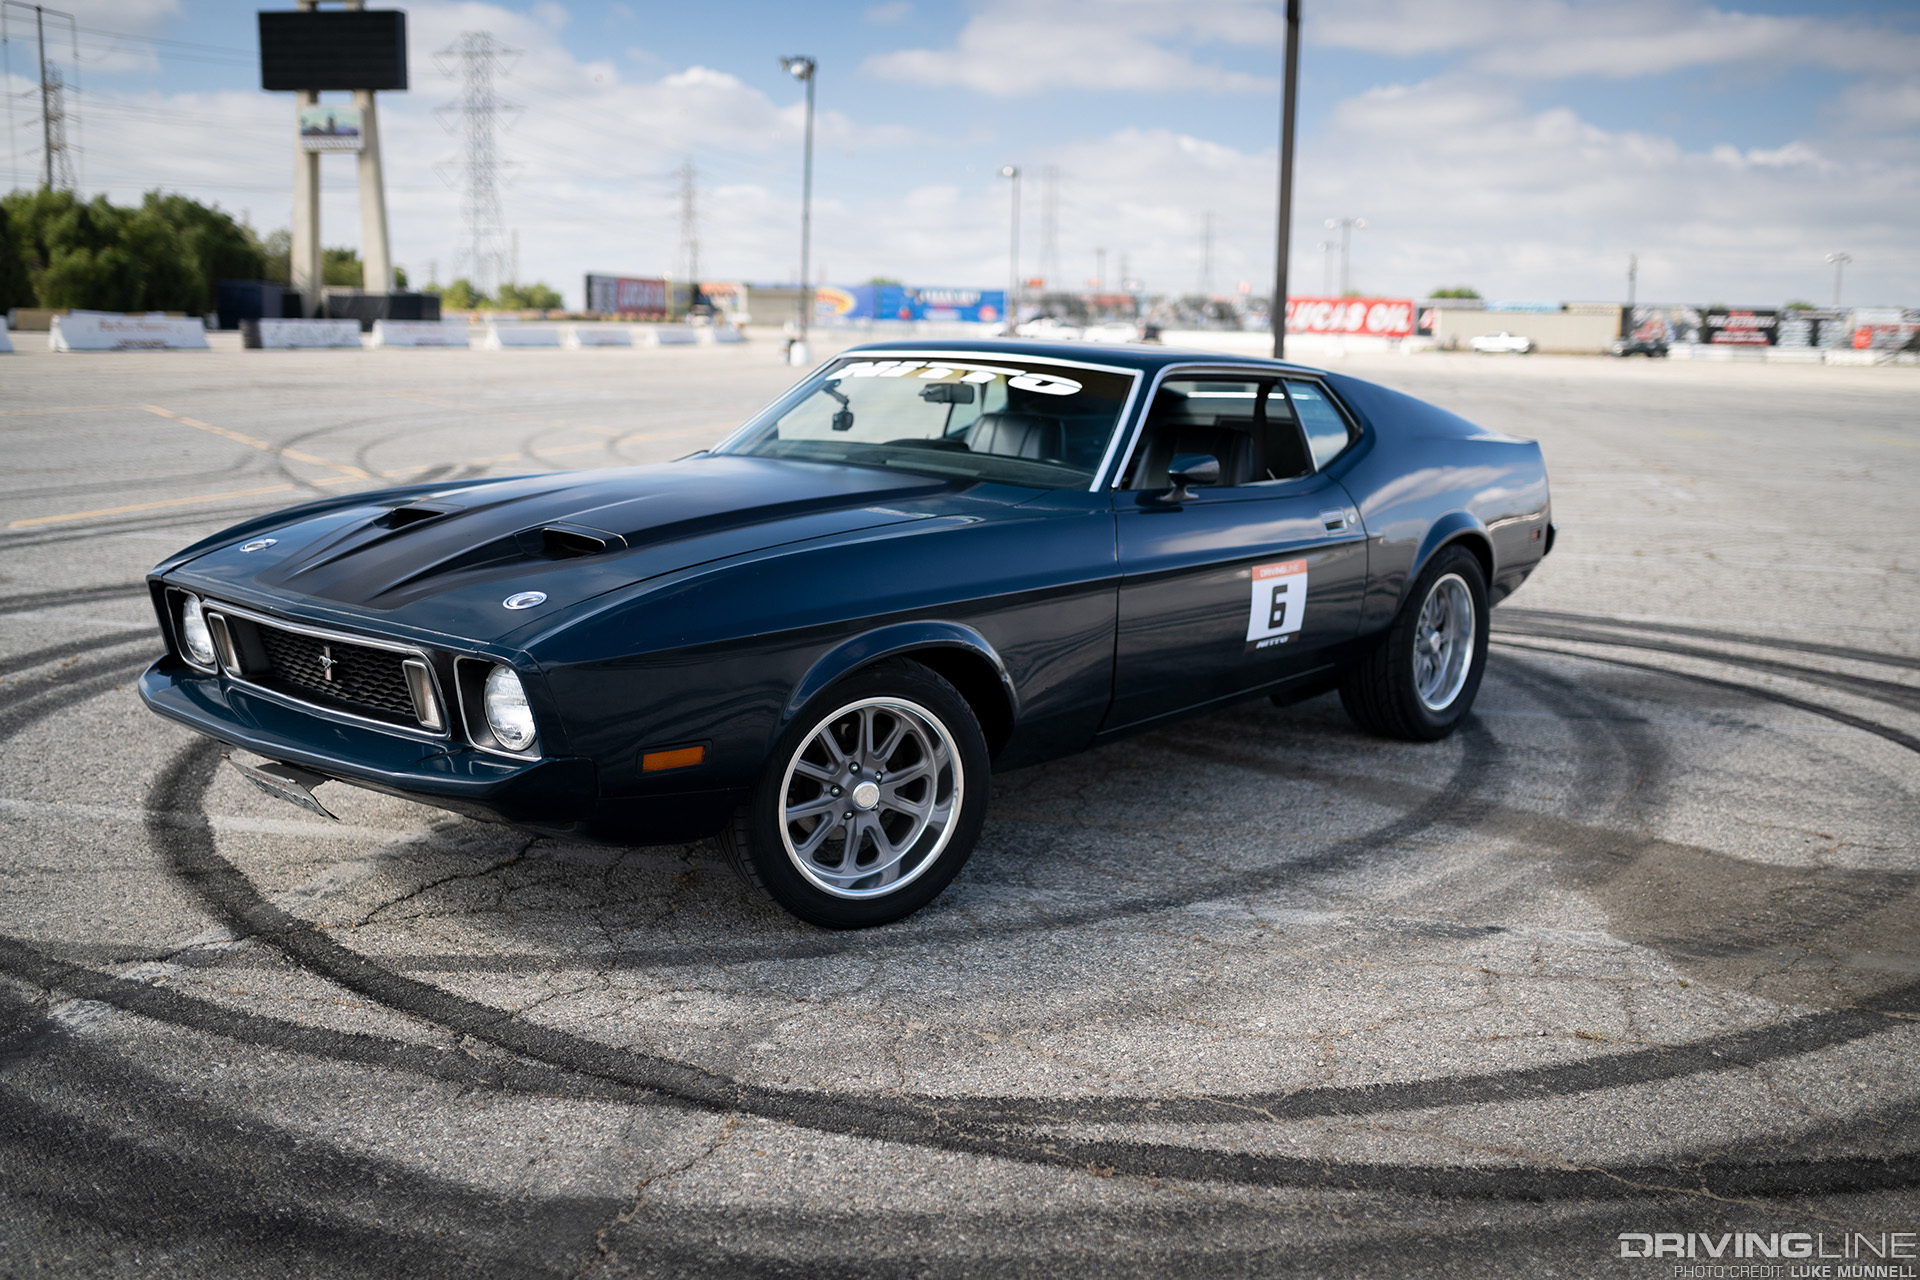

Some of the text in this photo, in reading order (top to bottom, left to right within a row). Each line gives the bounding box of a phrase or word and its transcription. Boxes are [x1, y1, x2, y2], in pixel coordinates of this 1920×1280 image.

[1366, 302, 1411, 333] OIL
[825, 361, 1083, 396] NITTO
[1268, 584, 1288, 629] 6
[1256, 635, 1289, 648] NITTO
